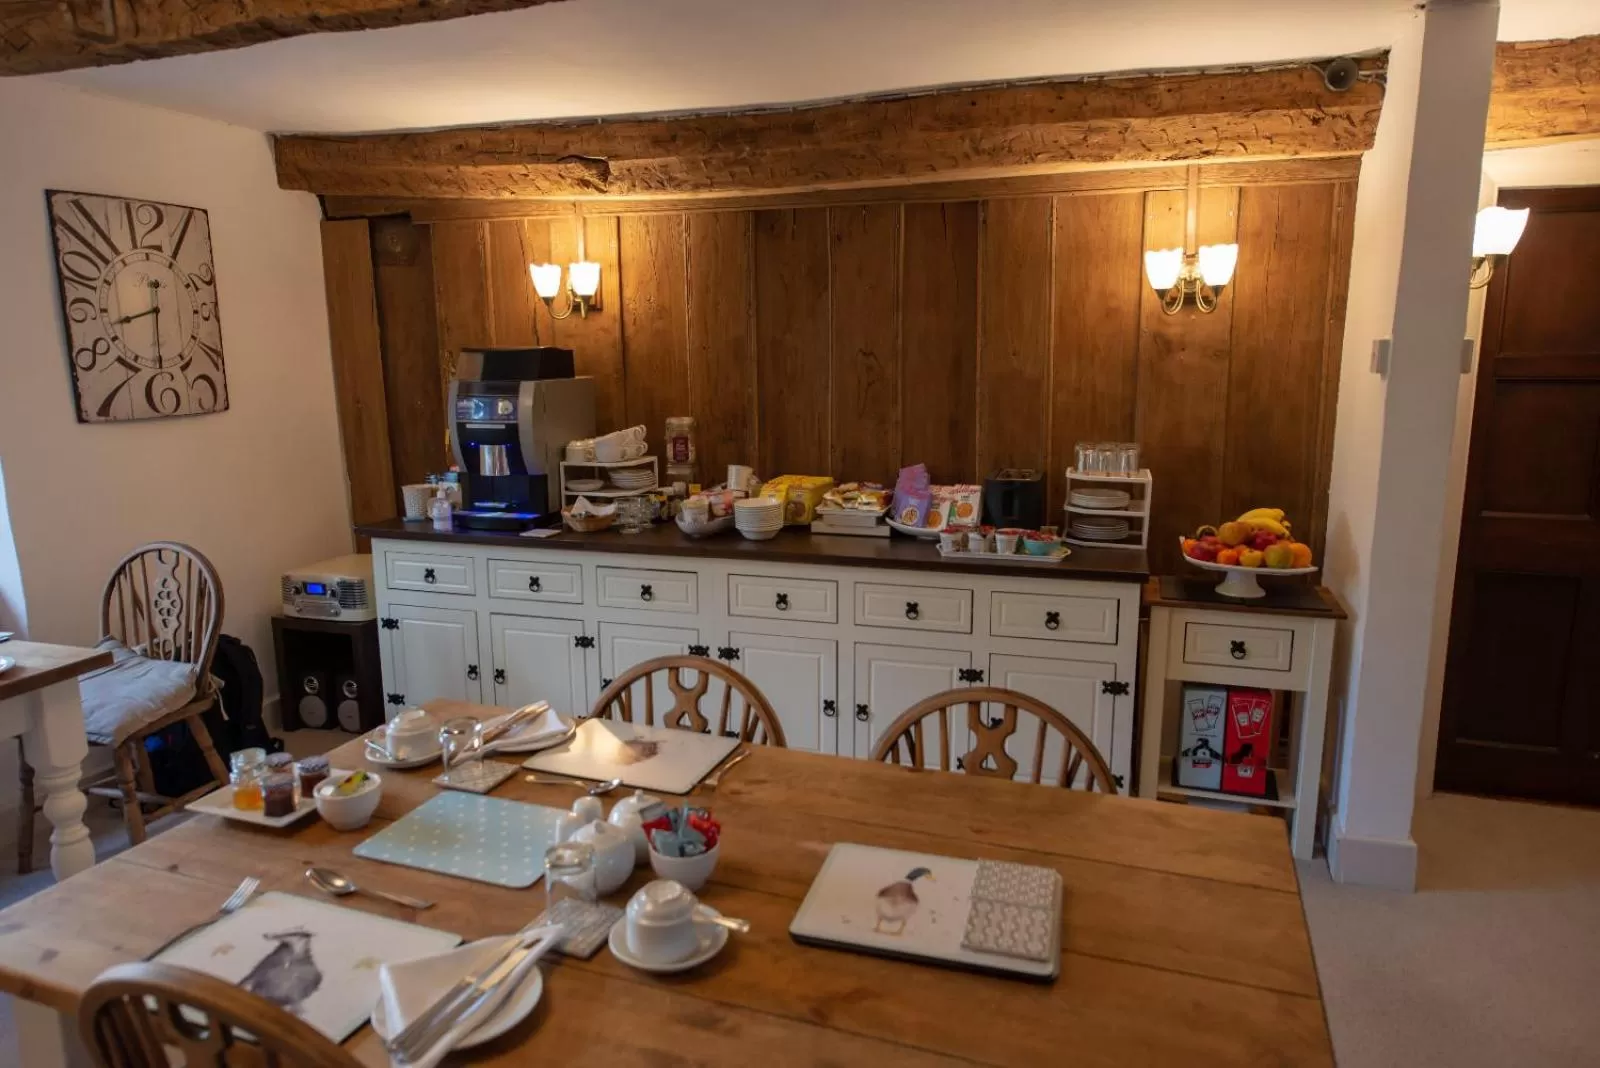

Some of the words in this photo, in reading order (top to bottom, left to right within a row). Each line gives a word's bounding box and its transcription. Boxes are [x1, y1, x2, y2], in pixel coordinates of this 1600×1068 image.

[124, 202, 164, 252] 12
[171, 210, 193, 260] 1
[62, 250, 101, 293] 10
[187, 262, 214, 292] 2
[69, 297, 97, 323] 9
[75, 337, 110, 371] 8
[97, 355, 142, 417] 7
[144, 371, 181, 414] 6
[180, 356, 217, 412] 5
